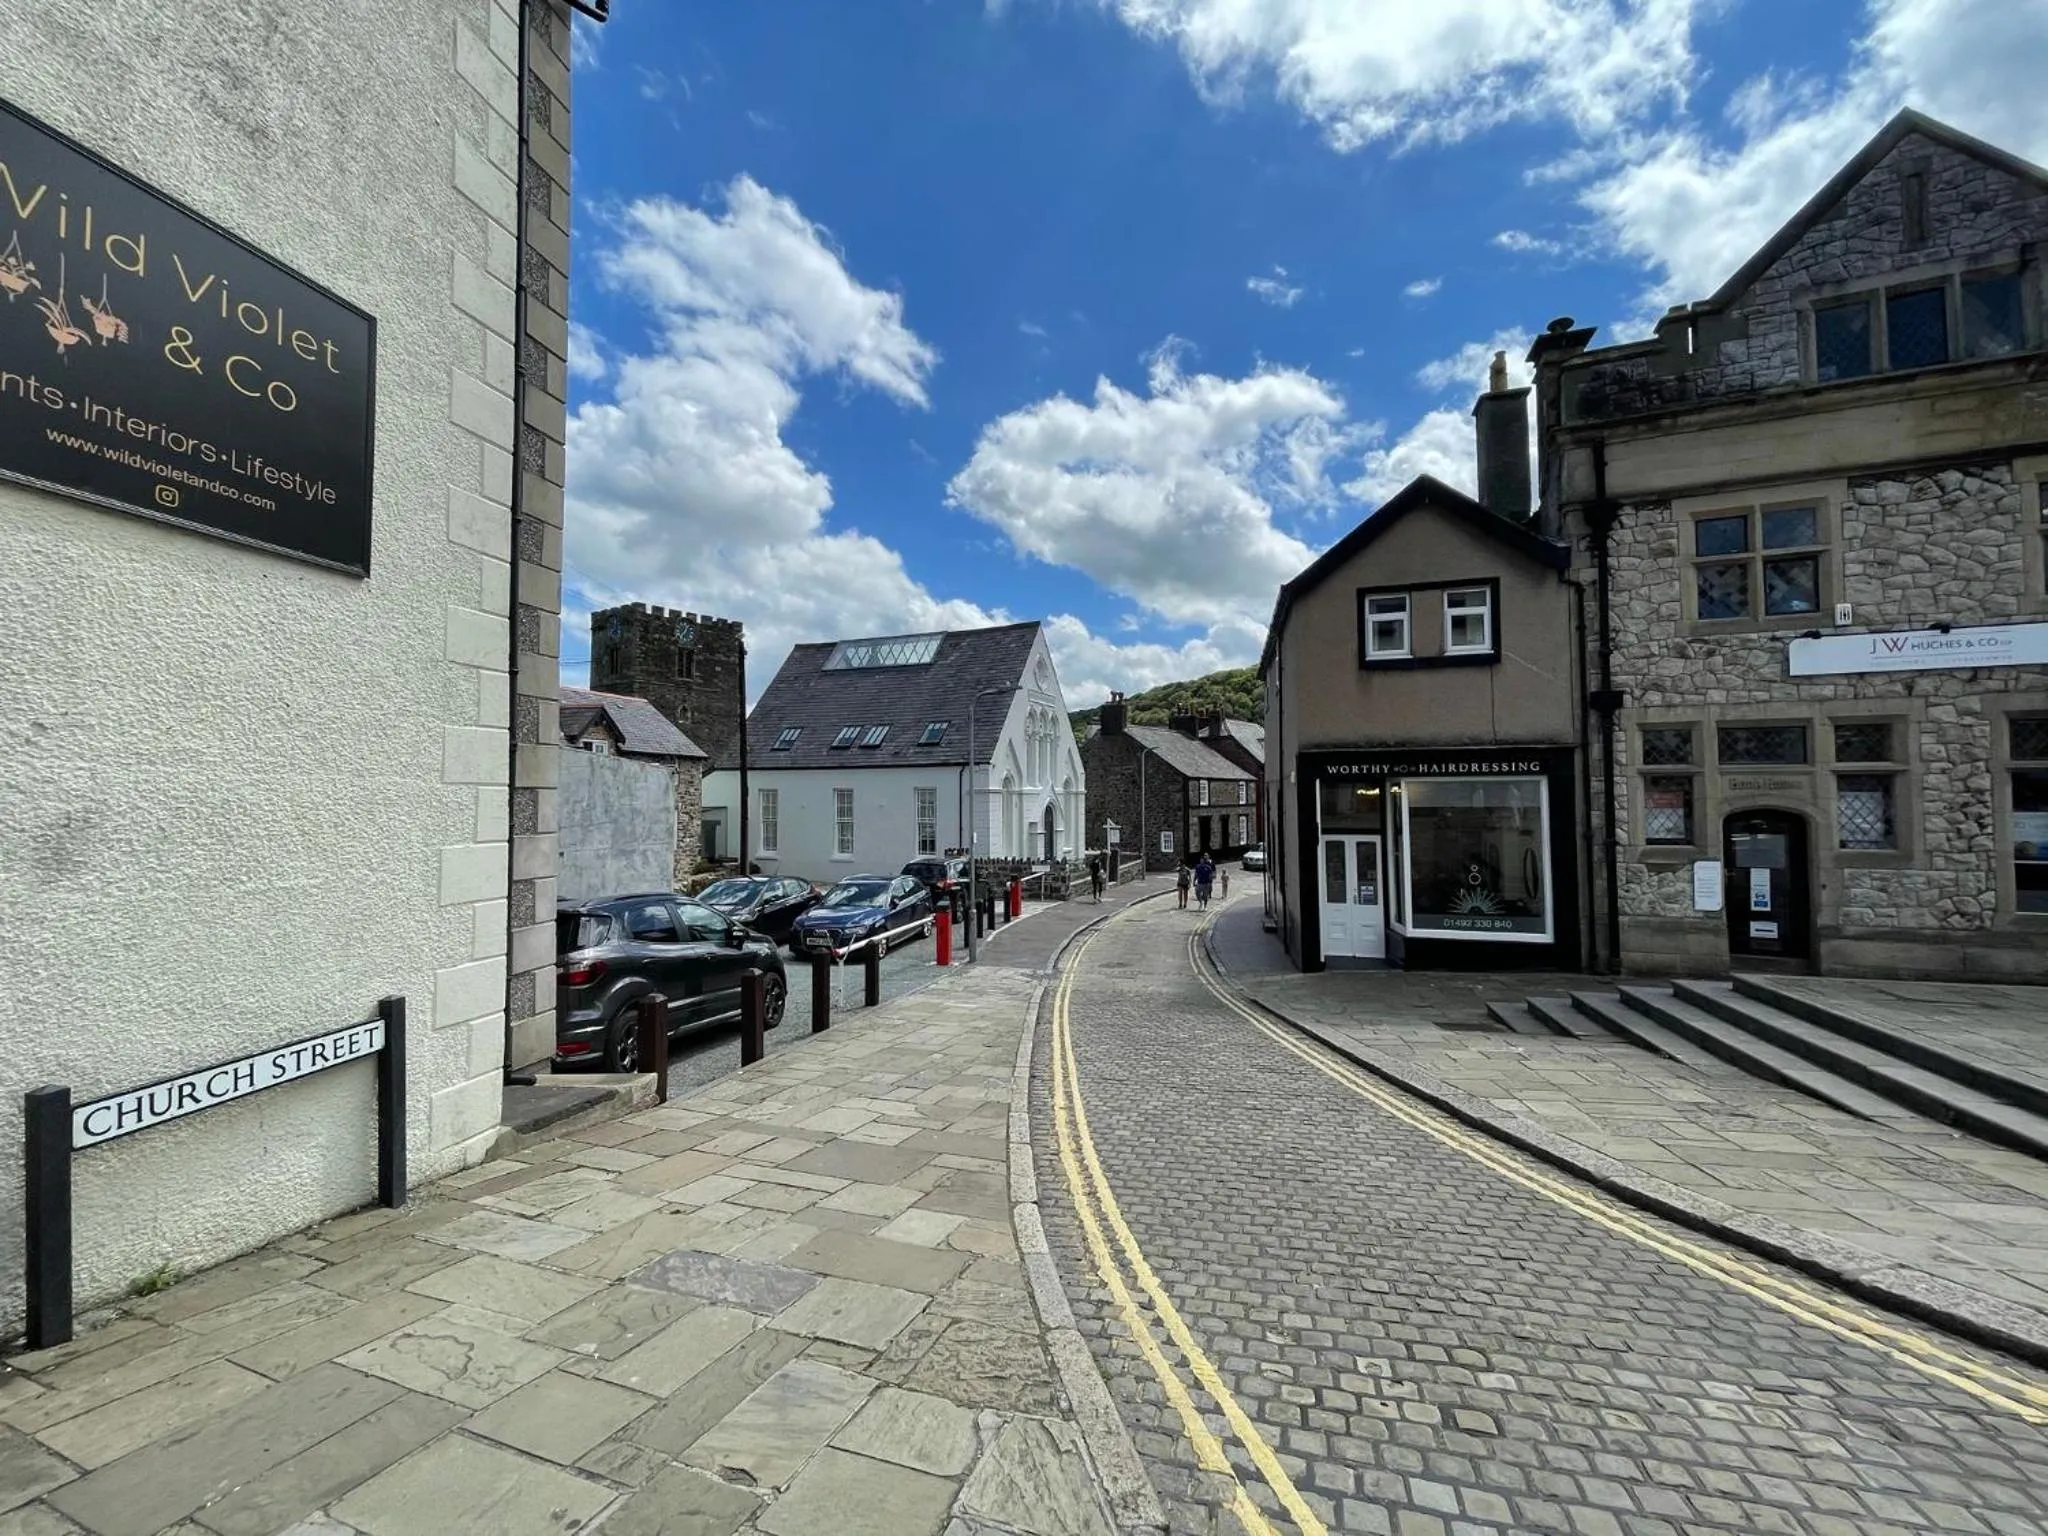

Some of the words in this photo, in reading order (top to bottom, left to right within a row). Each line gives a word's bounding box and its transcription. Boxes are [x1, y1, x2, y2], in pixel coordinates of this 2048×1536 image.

[172, 253, 340, 374] Violet
[164, 325, 203, 375] &
[225, 355, 297, 411] Co
[46, 428, 276, 511] www.wildvioletandco.com
[1326, 764, 1390, 774] WORTHY
[1419, 761, 1540, 773] HAIRDRESSING
[82, 1062, 256, 1137] CHURCH
[271, 1026, 381, 1080] STREET
